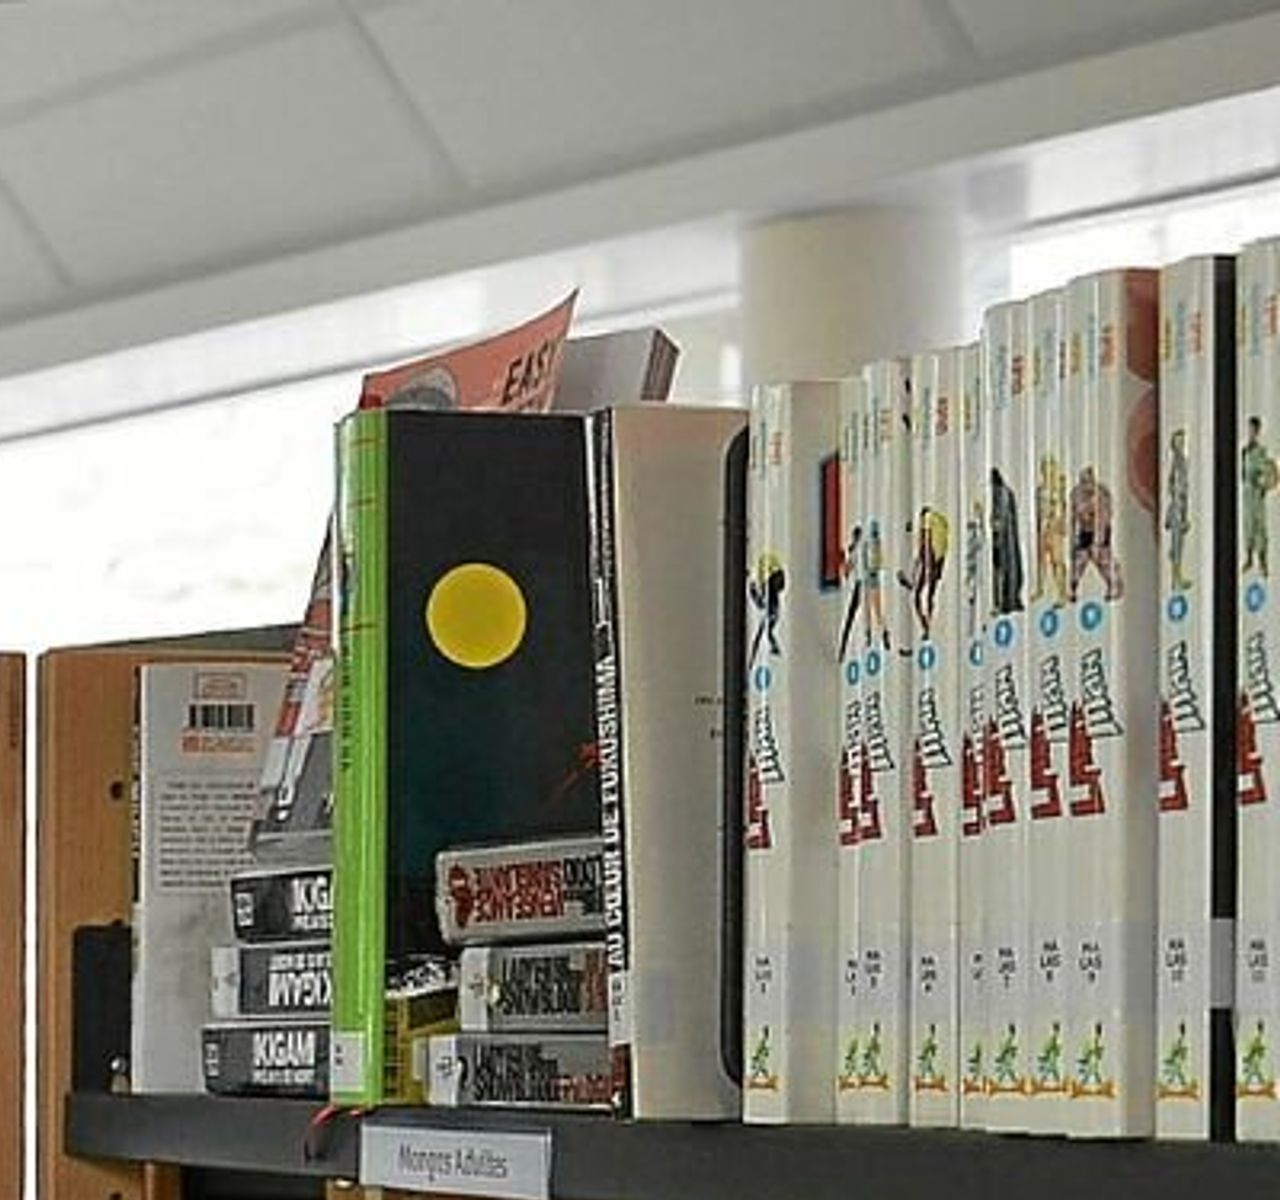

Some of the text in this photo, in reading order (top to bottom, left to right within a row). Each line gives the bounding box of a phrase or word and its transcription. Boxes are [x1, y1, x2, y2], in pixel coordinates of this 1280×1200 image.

[592, 653, 619, 801] FUKUSHIMA
[399, 1143, 508, 1182] Mangas Adultes
